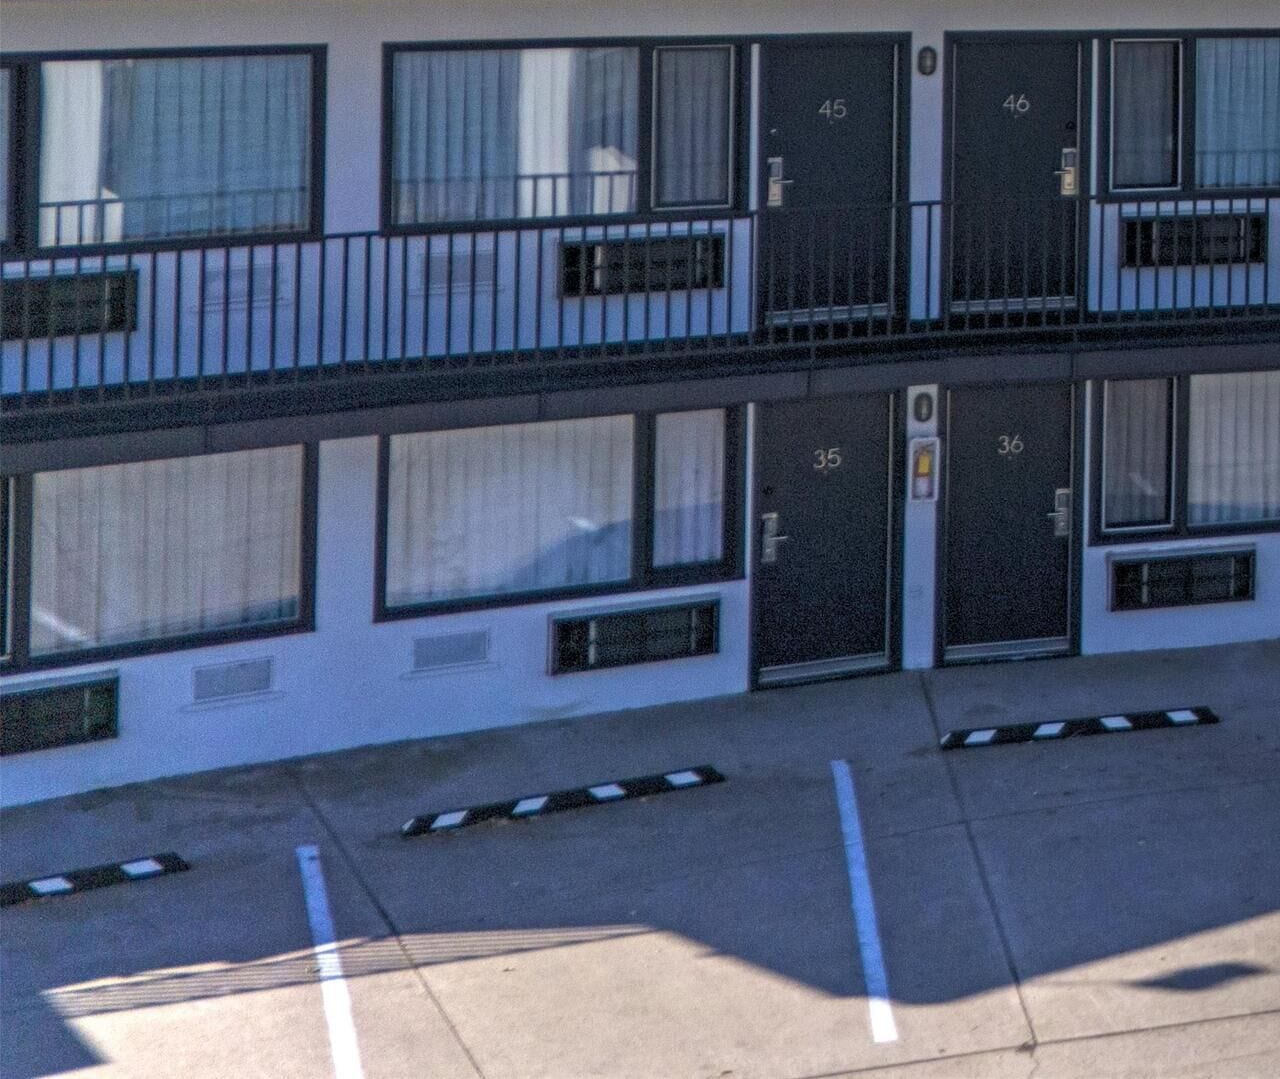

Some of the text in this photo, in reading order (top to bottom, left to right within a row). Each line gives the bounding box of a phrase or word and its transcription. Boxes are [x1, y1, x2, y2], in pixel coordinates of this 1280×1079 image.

[818, 99, 847, 118] 45
[1002, 94, 1030, 112] 46
[998, 435, 1024, 454] 36
[813, 447, 842, 468] 35
